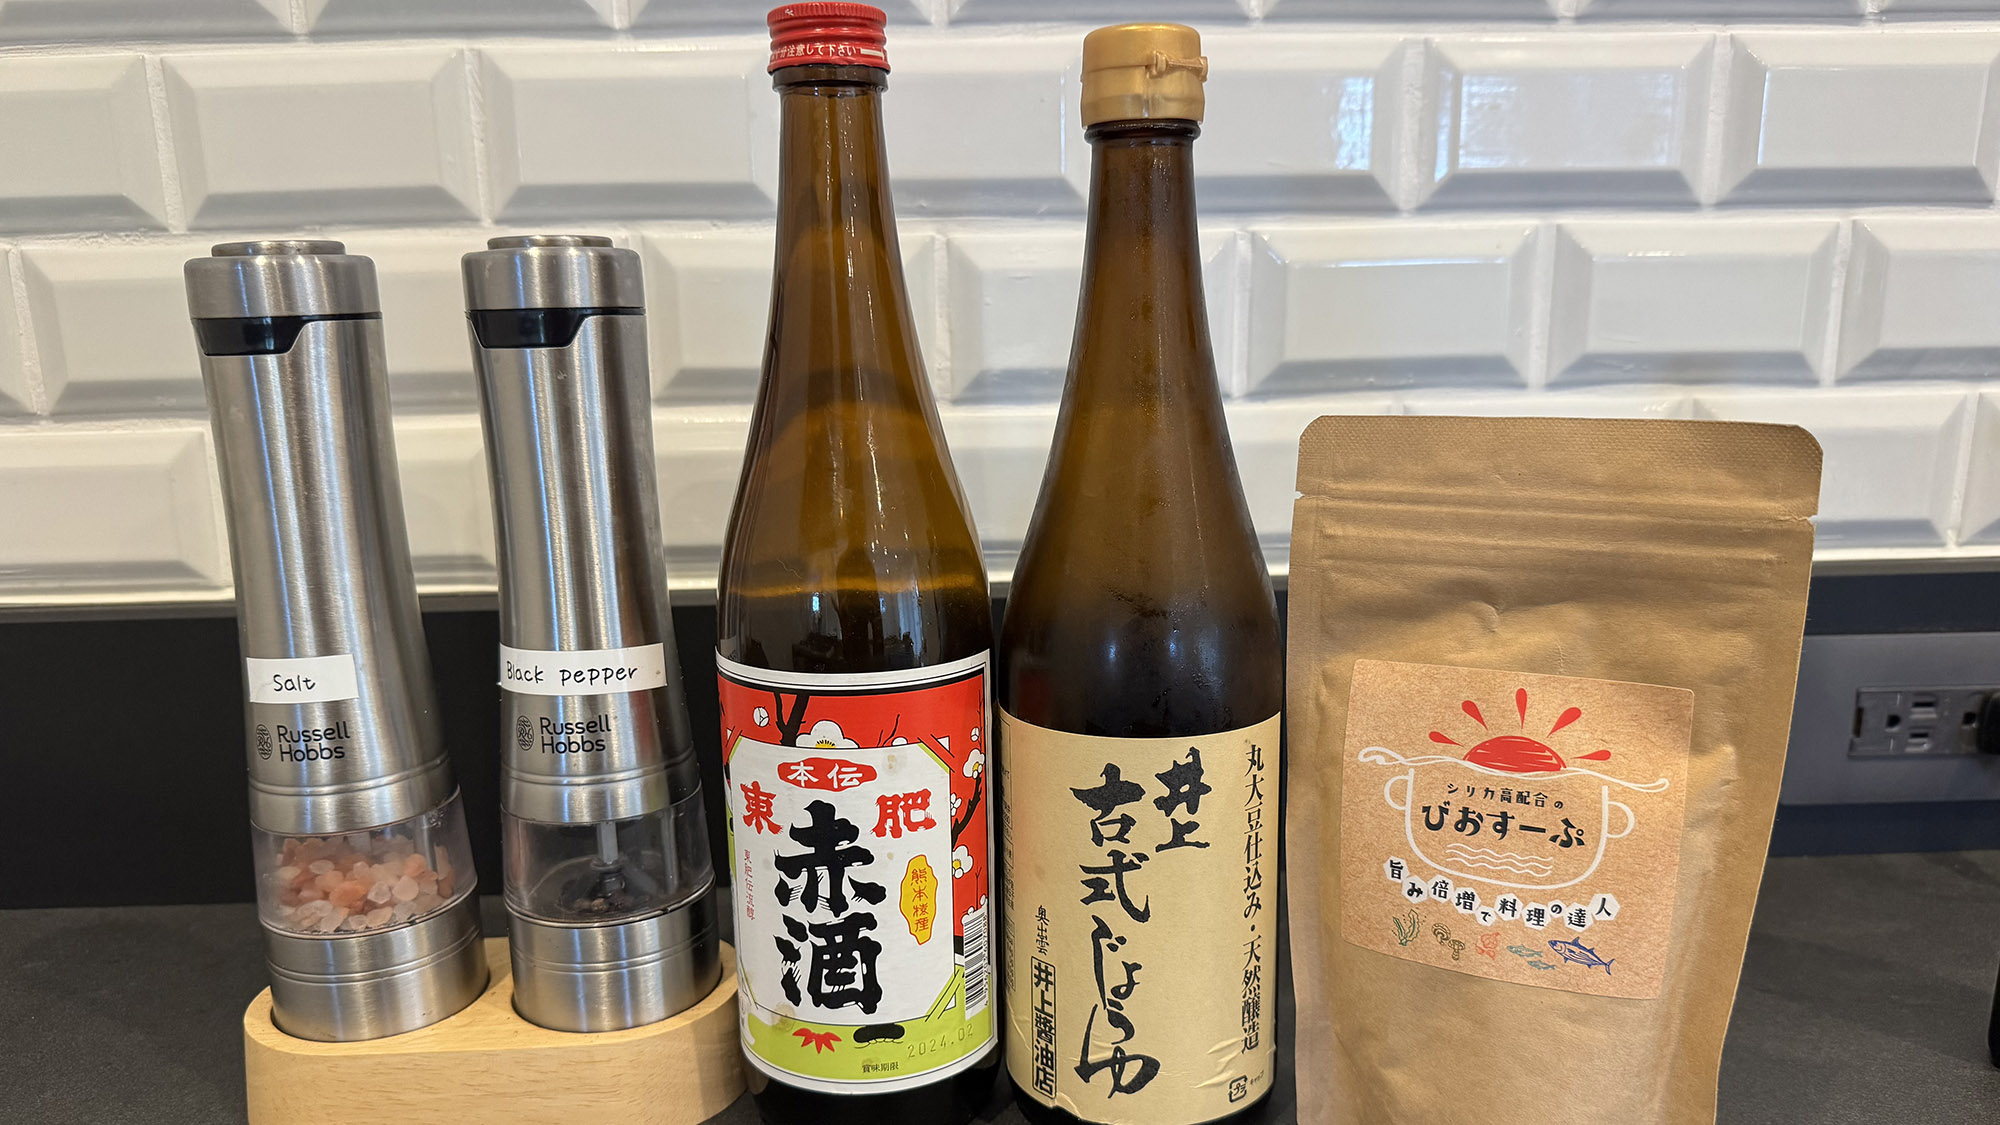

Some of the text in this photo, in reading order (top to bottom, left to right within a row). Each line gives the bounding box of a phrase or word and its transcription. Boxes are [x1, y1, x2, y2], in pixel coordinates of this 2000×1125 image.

[273, 674, 316, 692] Salt
[506, 664, 639, 687] Black pepper
[277, 721, 351, 743] Russell
[540, 714, 612, 735] Russell
[279, 743, 345, 762] Hobbs
[541, 735, 606, 754] Hobbs
[787, 761, 864, 788] 本伝
[1154, 746, 1213, 853] 井上
[1447, 783, 1565, 811] シリカ高配合の
[1422, 801, 1586, 849] びおすーぷ
[774, 799, 887, 1015] 赤酒
[1388, 857, 1613, 930] 旨み倍増で料理の達人
[1070, 763, 1161, 1099] 古式じょうゆ
[907, 1023, 974, 1059] 2024.02
[862, 1060, 900, 1074] 賞味期限
